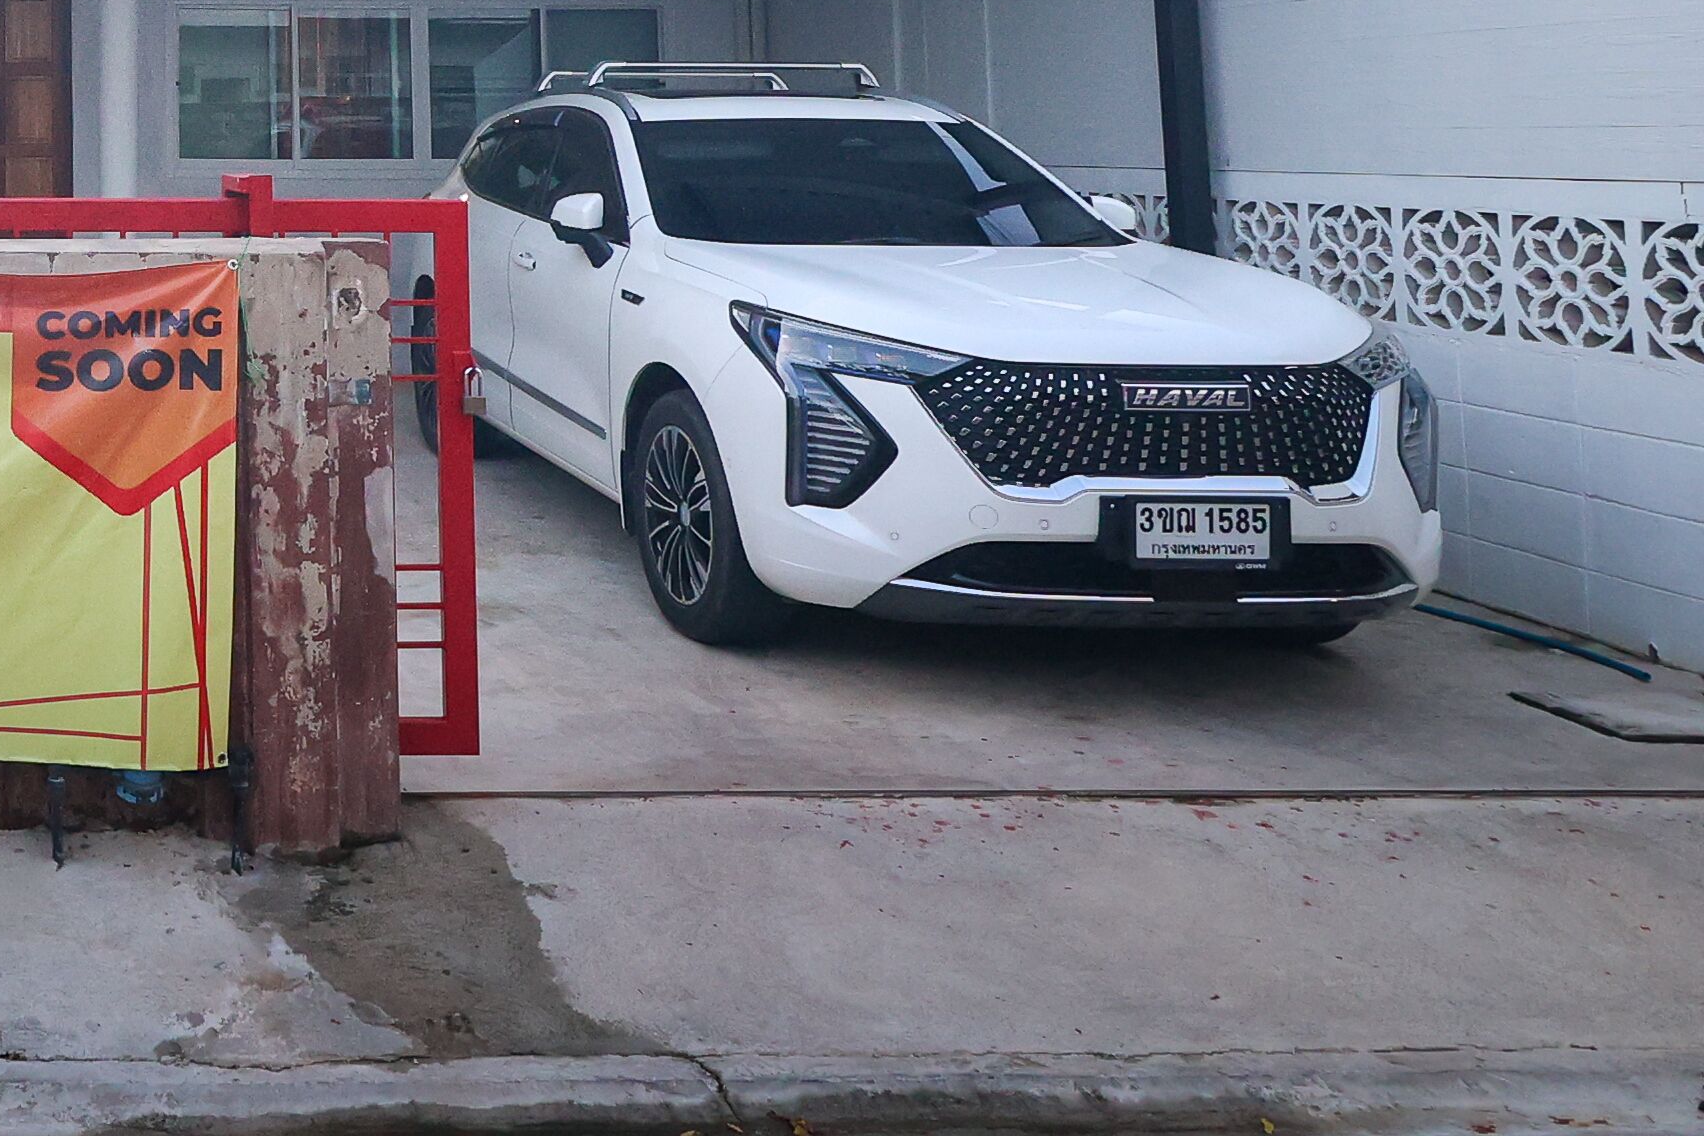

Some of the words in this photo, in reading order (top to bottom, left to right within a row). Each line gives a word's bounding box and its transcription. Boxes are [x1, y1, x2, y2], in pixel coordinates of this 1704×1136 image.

[36, 307, 222, 340] COMING
[36, 348, 222, 391] SOON
[1132, 388, 1245, 406] HAVAL
[1139, 507, 1196, 533] 3ขฌ
[1205, 507, 1267, 534] 1585
[1151, 543, 1256, 558] กรุงเทพมหานคร
